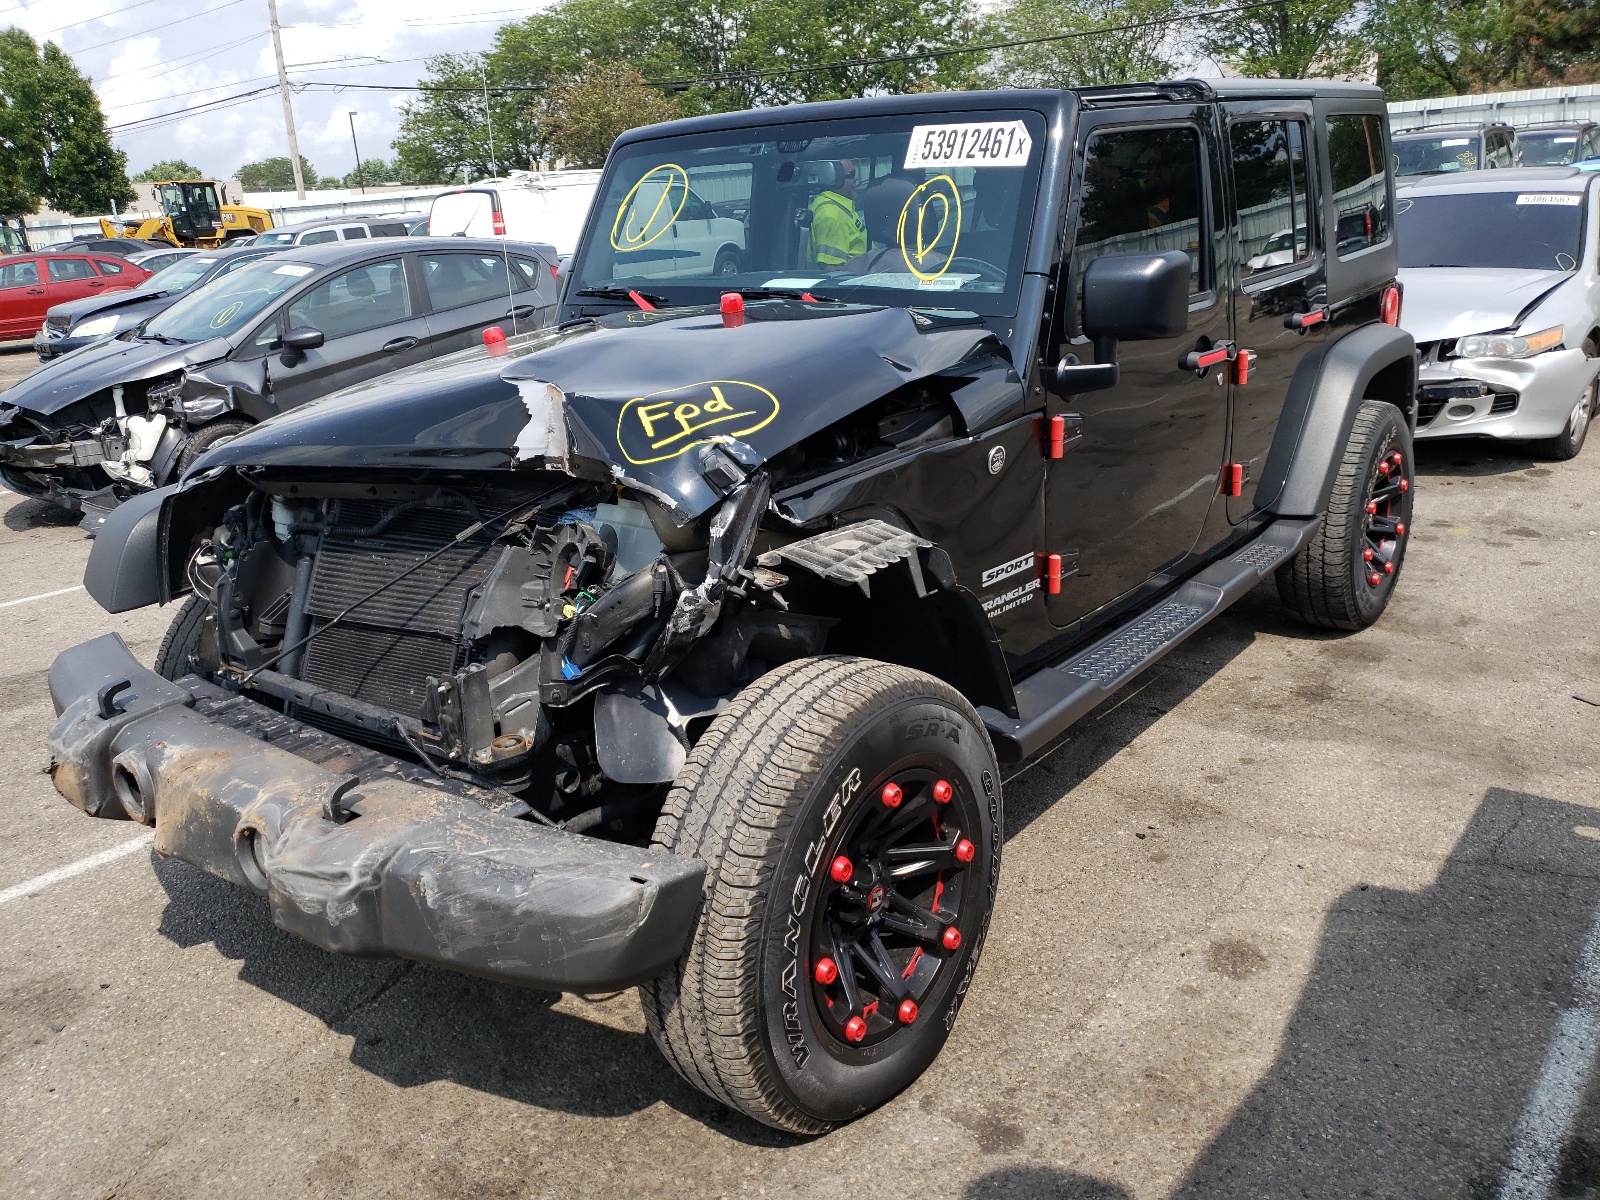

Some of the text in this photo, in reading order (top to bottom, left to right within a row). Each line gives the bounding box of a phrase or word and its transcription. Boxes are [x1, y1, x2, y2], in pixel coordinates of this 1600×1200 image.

[921, 126, 1017, 161] 53912461
[985, 555, 1034, 583] SPORT
[781, 767, 862, 1070] WRANGLER
[942, 769, 1000, 1031] GOODYEAR
